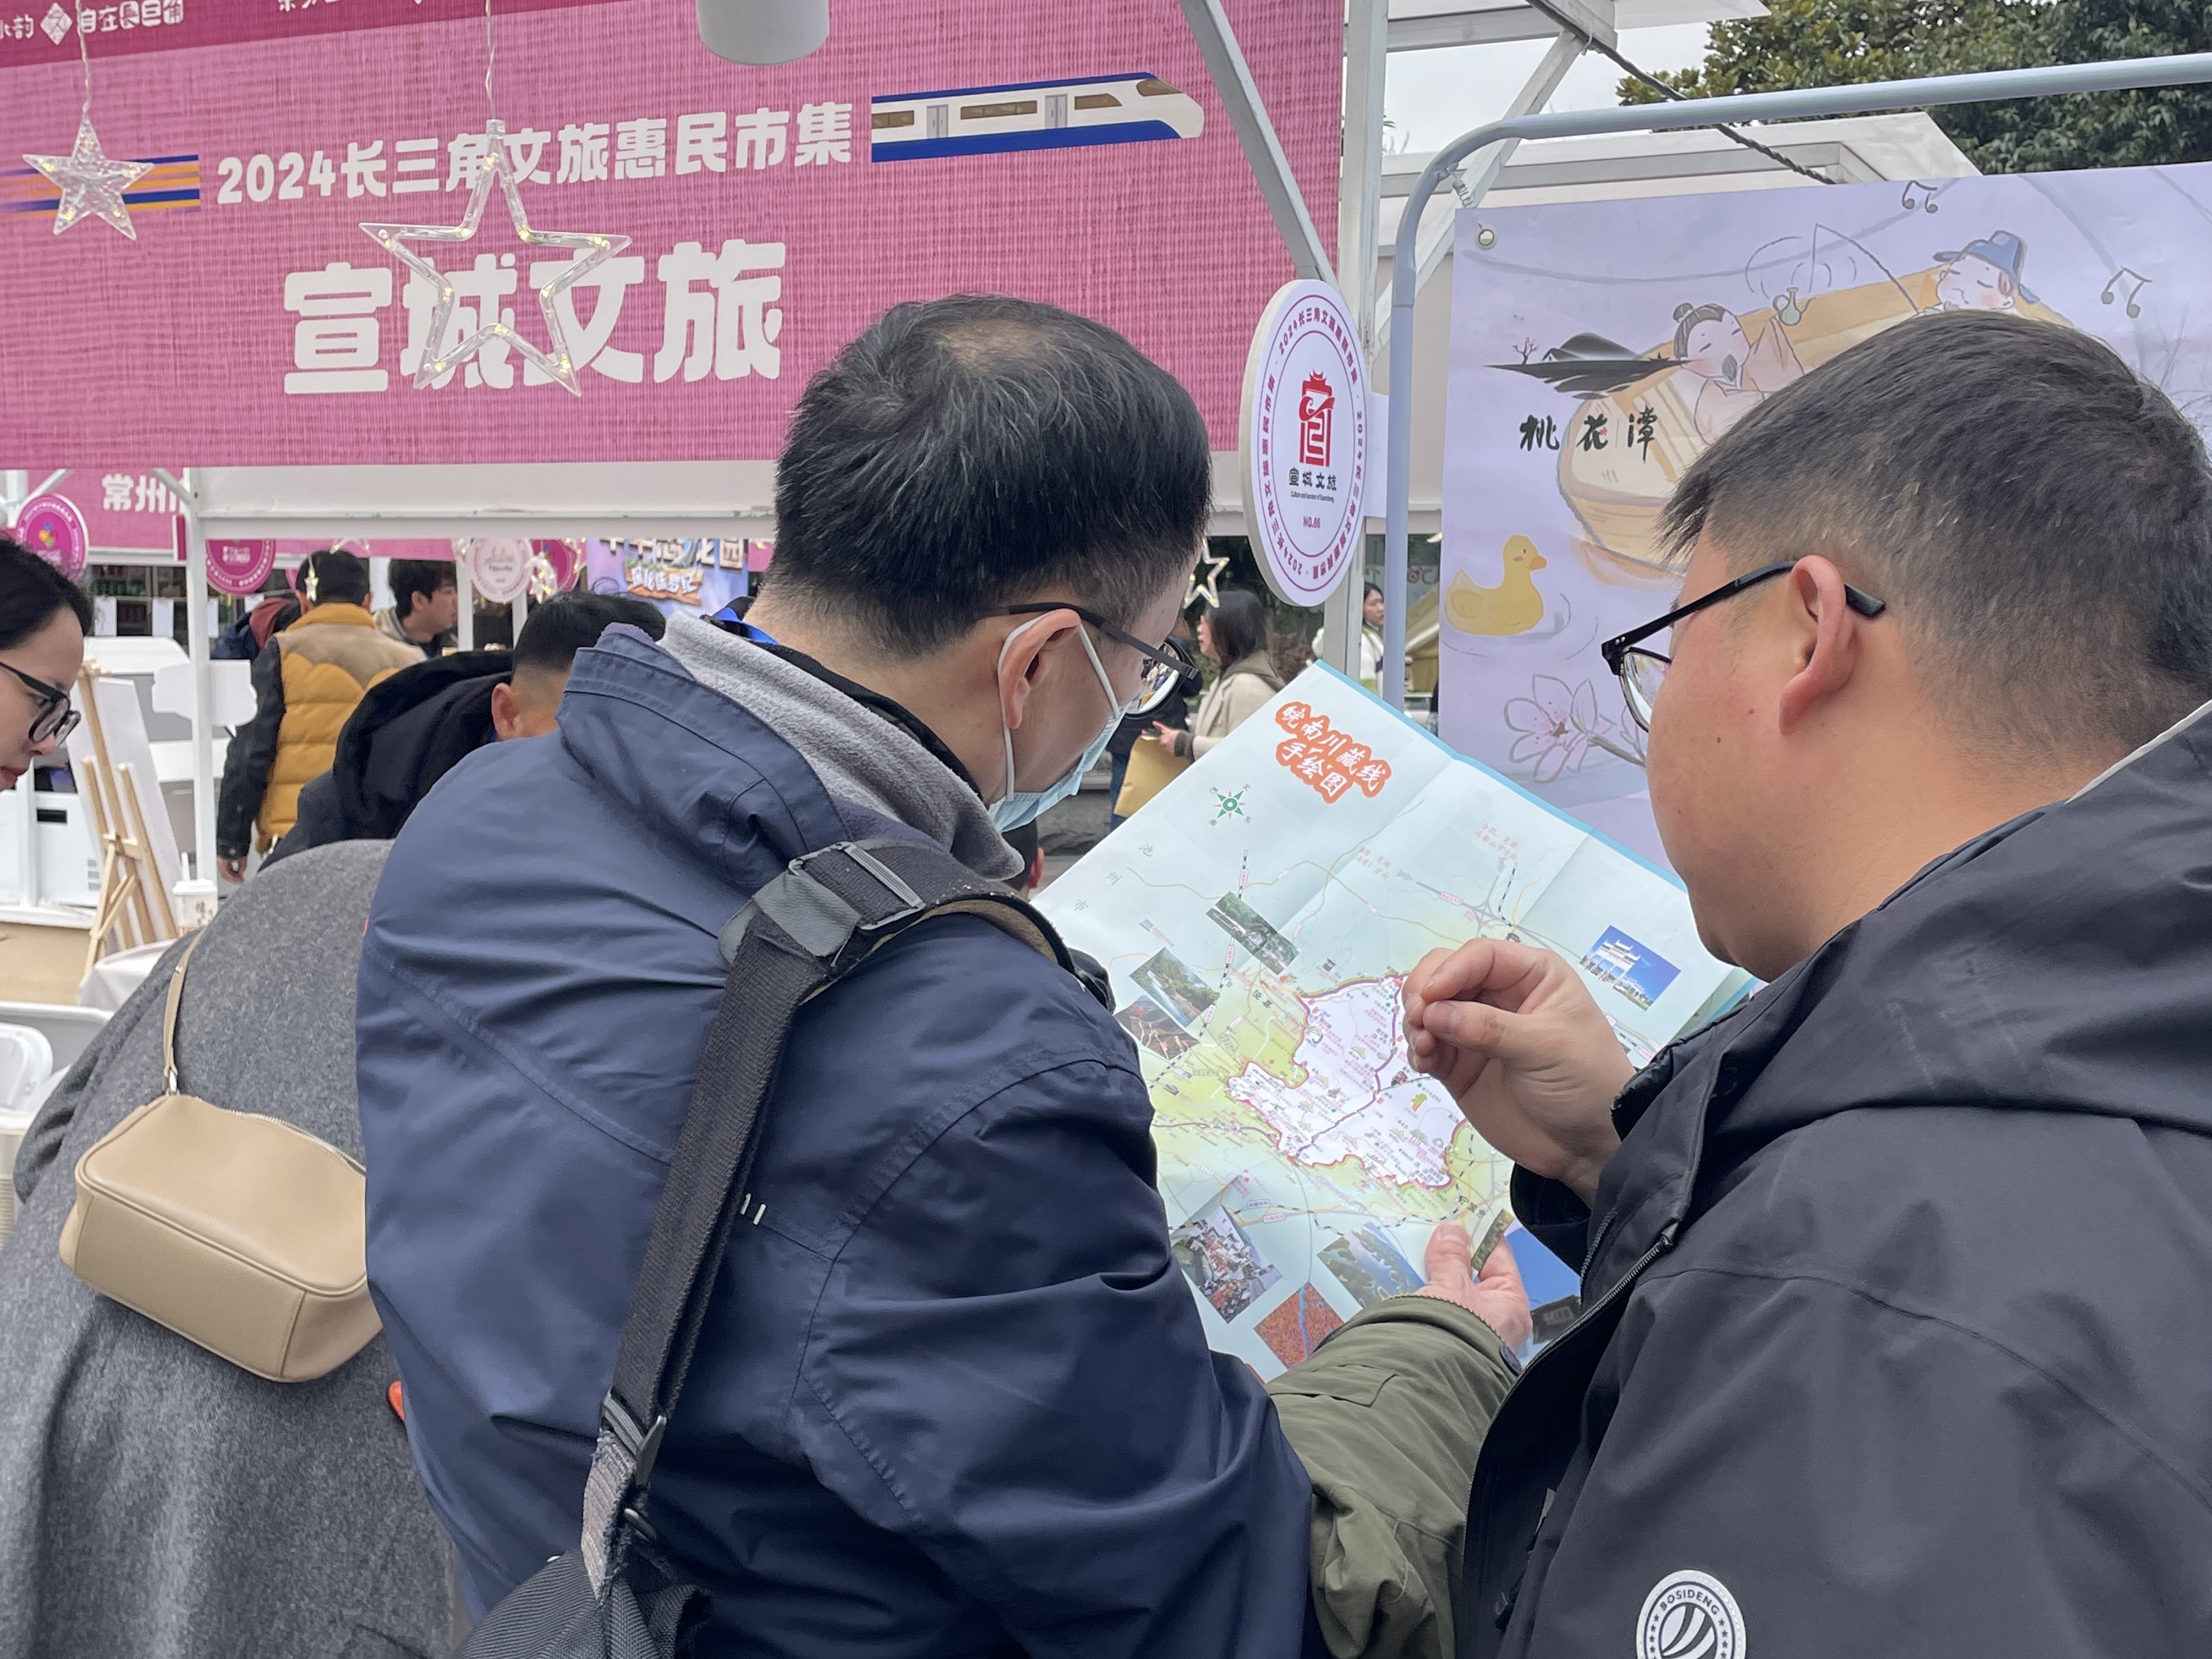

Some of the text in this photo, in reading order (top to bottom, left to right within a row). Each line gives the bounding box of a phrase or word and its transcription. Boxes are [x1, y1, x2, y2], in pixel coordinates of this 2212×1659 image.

[217, 101, 853, 205] 2024长三角文旅惠民市集
[283, 239, 786, 395] 宣城文旅
[1519, 405, 1658, 463] 桃花潭
[1289, 466, 1337, 491] 宣城文旅
[1281, 705, 1387, 792] 皖南川藏线
[1282, 742, 1348, 798] 手绘图
[1659, 1589, 1720, 1616] BOSIDENG
